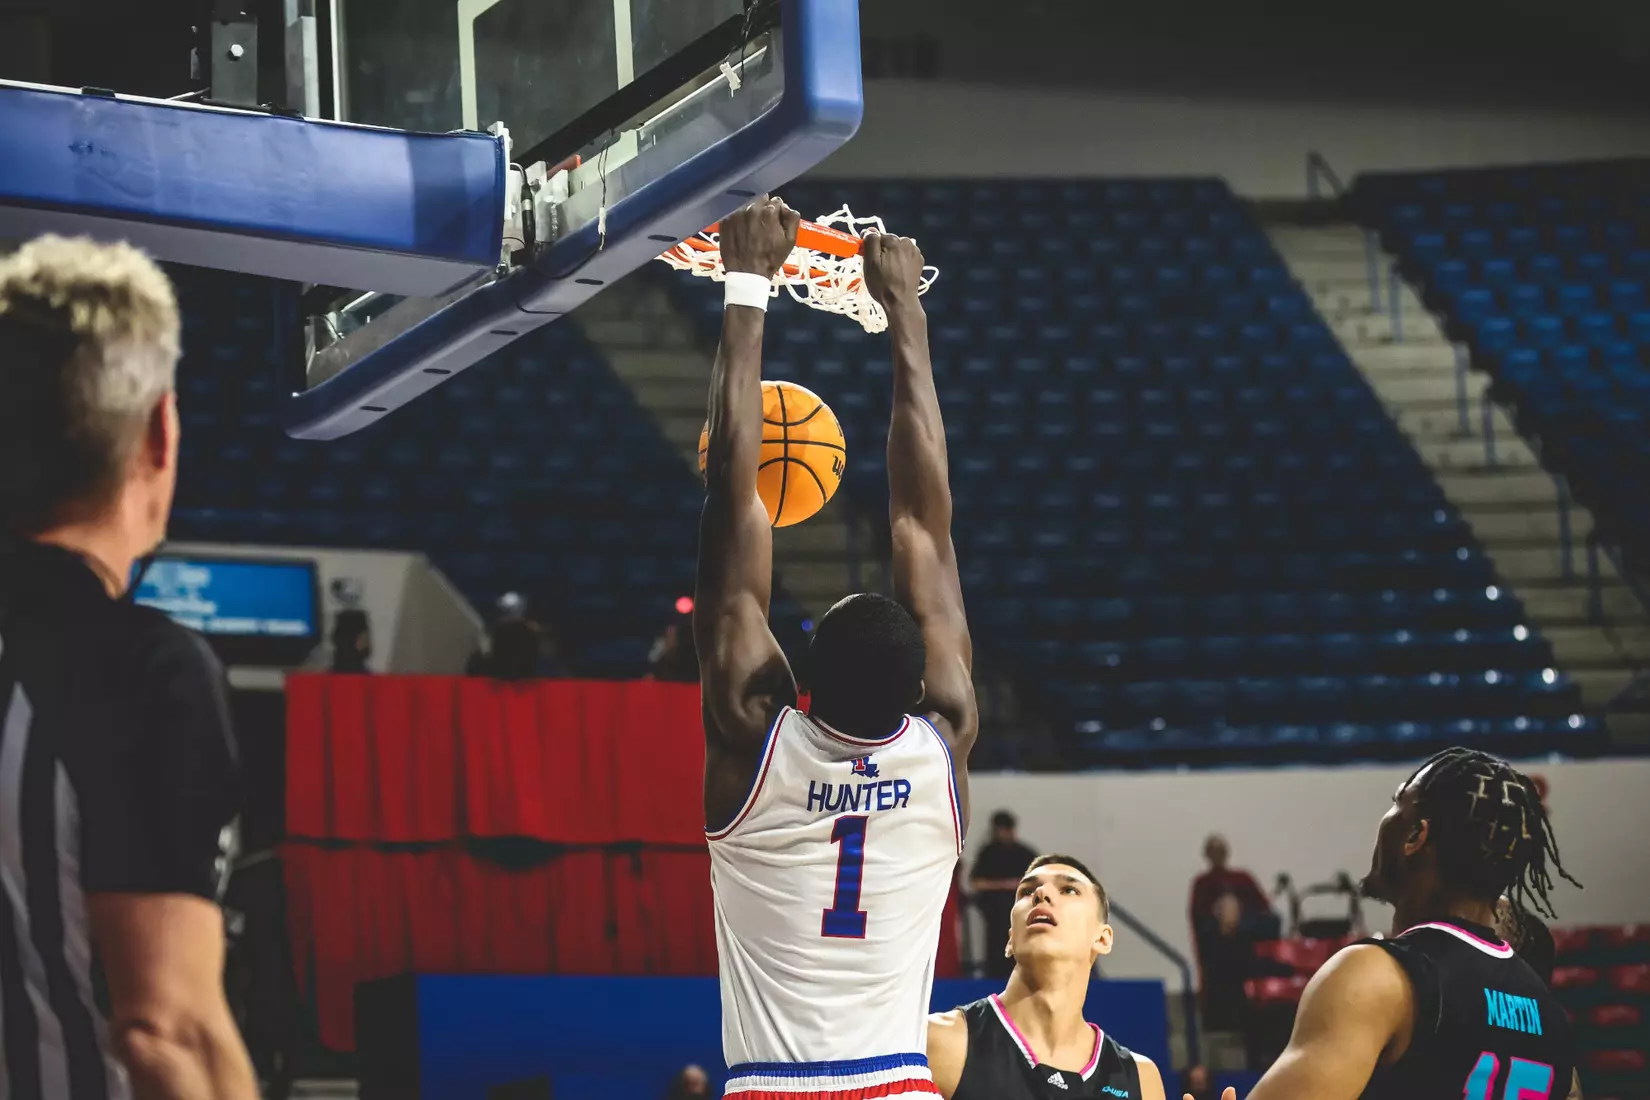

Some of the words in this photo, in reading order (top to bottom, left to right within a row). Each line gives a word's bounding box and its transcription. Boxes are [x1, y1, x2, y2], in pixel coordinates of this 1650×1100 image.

[806, 778, 912, 812] HUNTER
[820, 815, 869, 939] 1
[1484, 988, 1542, 1035] MARTIN
